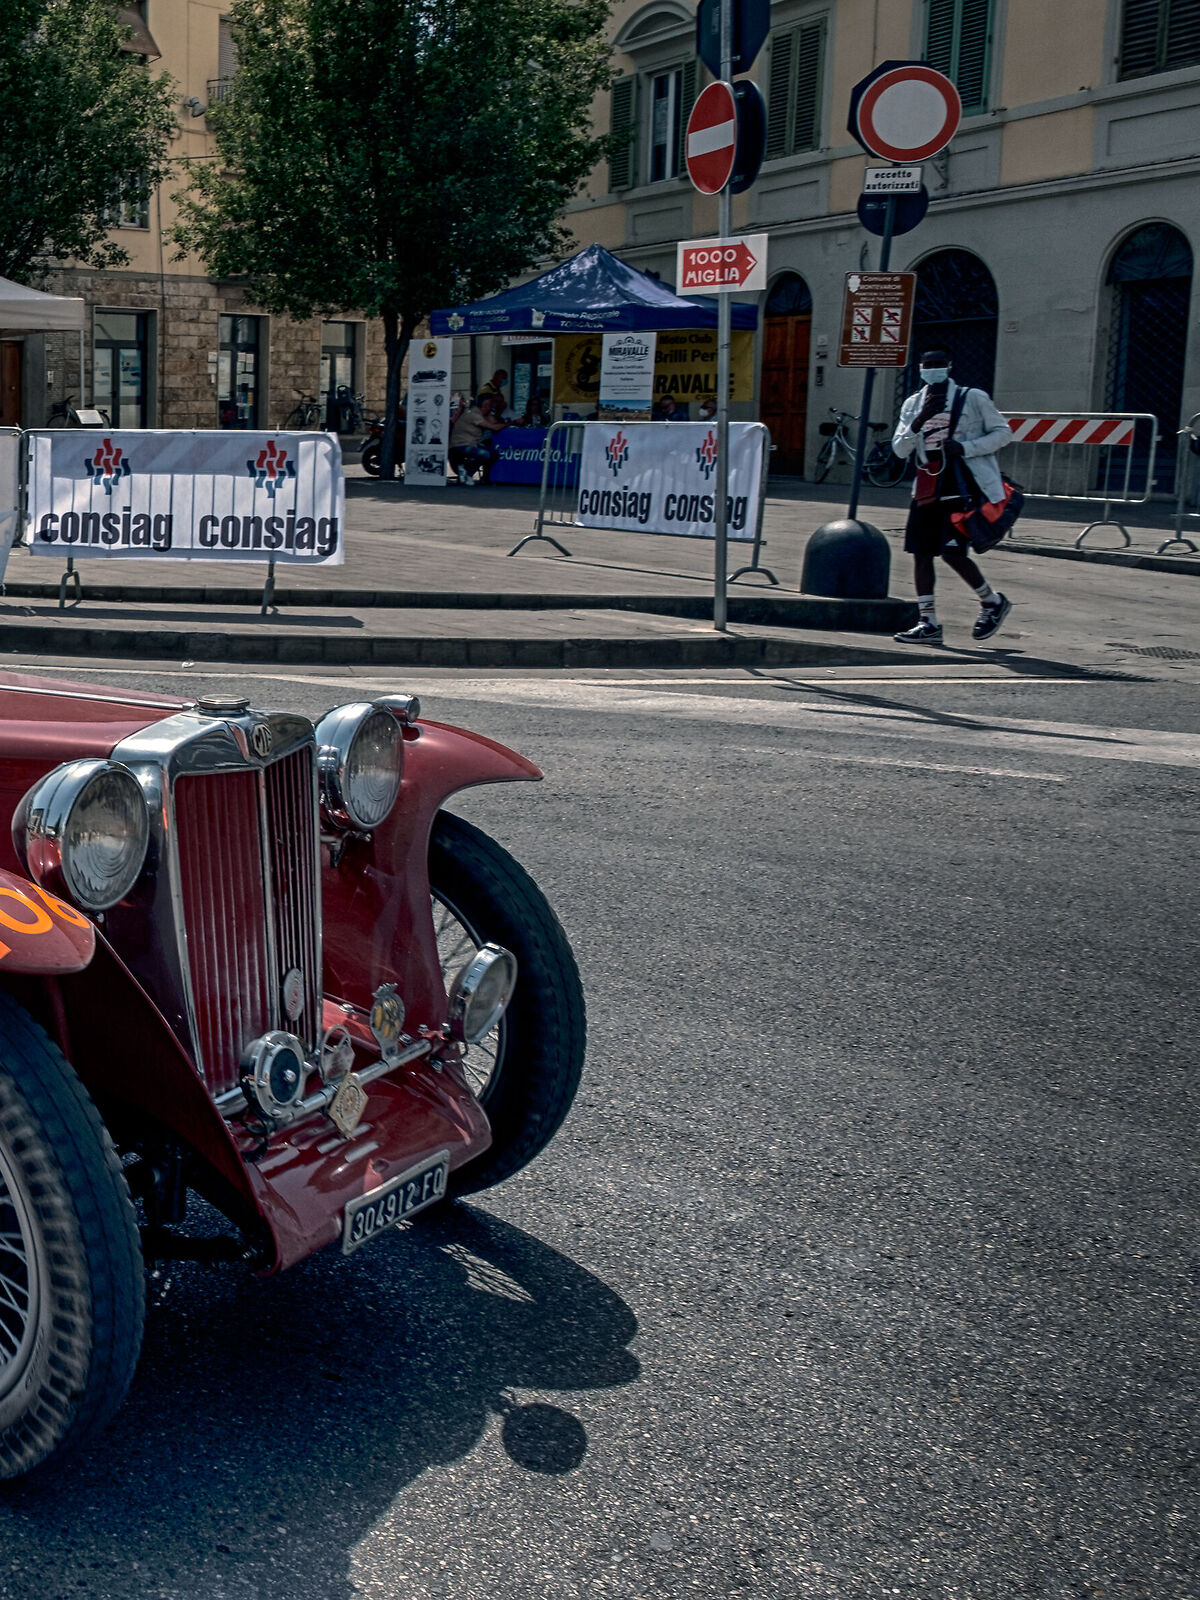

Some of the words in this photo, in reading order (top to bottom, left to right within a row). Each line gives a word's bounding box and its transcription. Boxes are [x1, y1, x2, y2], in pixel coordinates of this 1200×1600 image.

[874, 170, 912, 179] eccetto
[866, 181, 920, 190] autorizzati
[689, 249, 737, 265] 1000
[685, 267, 740, 284] MIGLIA
[579, 310, 620, 321] Regionale
[659, 336, 687, 344] Moto
[688, 334, 712, 344] Club
[608, 346, 649, 356] MIRAVALLE
[655, 350, 687, 363] Brilli
[691, 349, 718, 363] Per
[579, 485, 652, 524] consiag
[664, 493, 748, 530] consag
[39, 505, 174, 552] consiag
[199, 509, 338, 556] consiag
[353, 1182, 416, 1241] 304912
